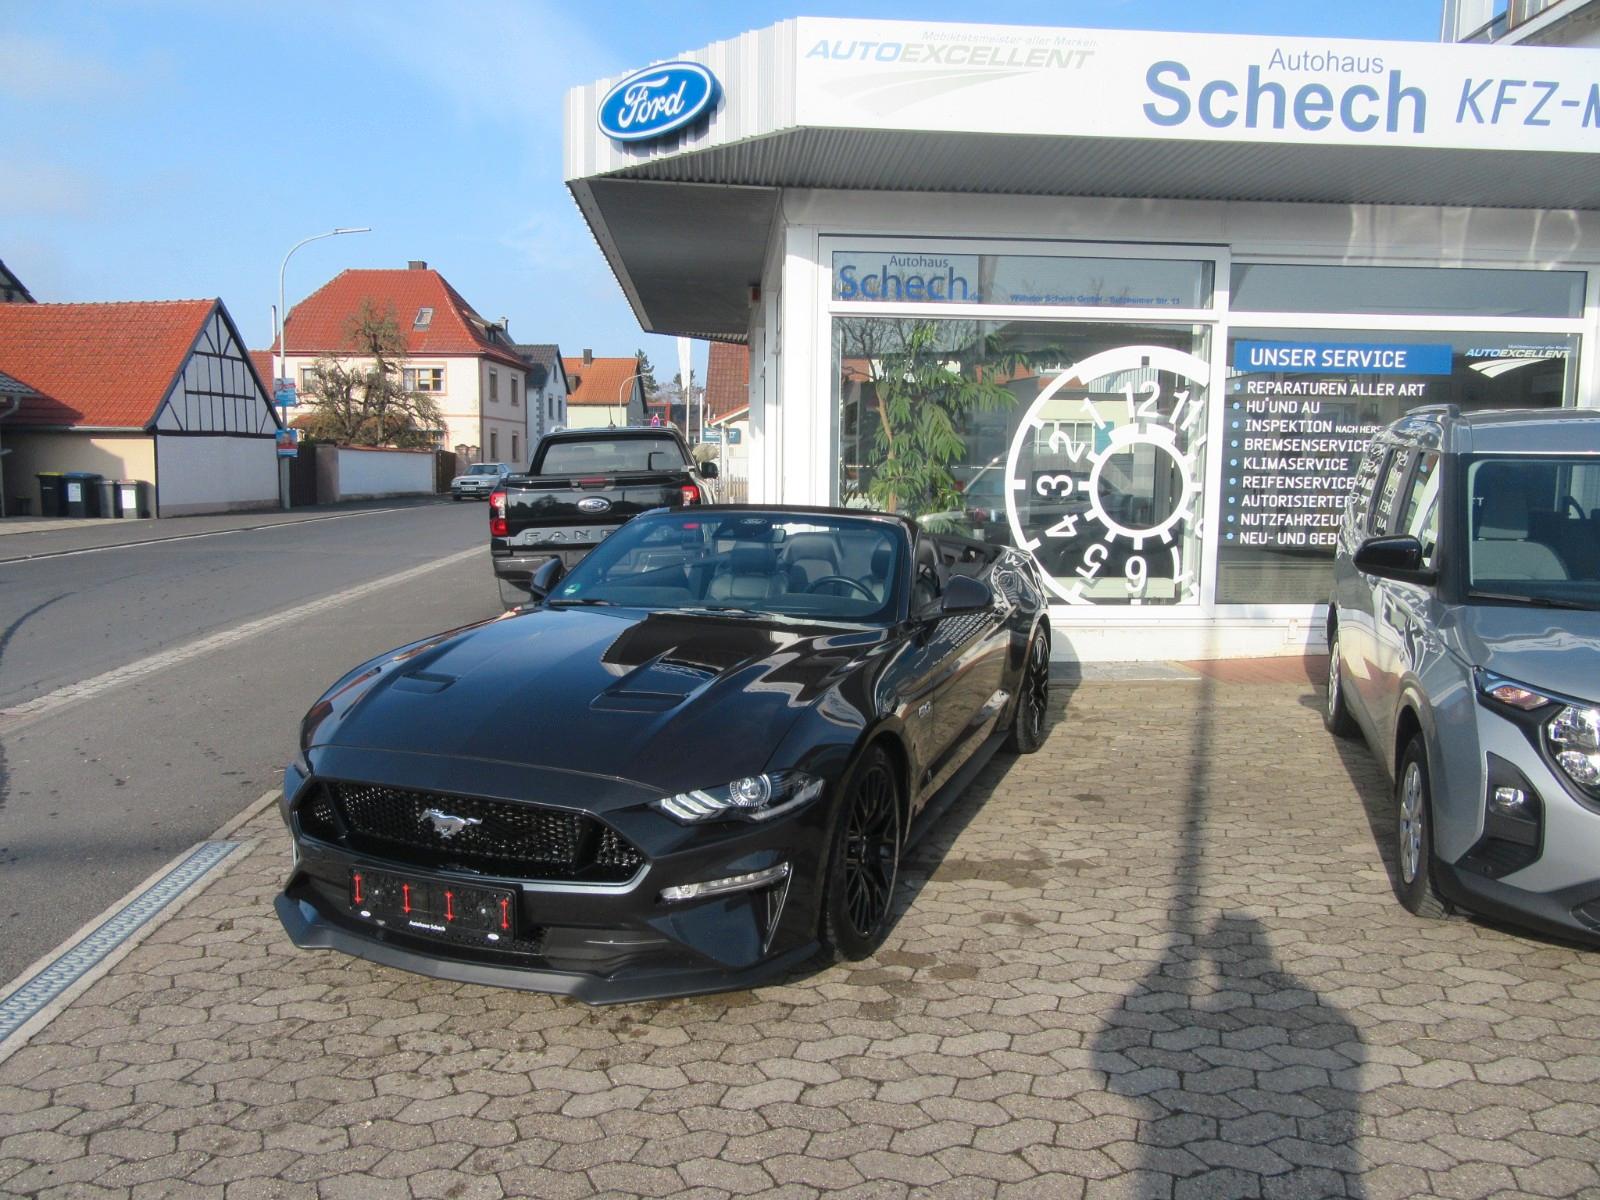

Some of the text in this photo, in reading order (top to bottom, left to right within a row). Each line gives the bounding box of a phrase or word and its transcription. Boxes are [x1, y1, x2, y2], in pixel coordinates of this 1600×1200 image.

[805, 39, 1095, 70] AUTOEXCELLENT
[1268, 48, 1384, 74] Autohaus
[618, 75, 687, 128] Ford
[1142, 60, 1427, 133] Schech
[889, 255, 949, 268] Autohaus
[839, 265, 968, 300] Schech
[1251, 348, 1407, 368] UNSER SERVICE
[1465, 348, 1572, 359] AUTOEXCELLENT
[1247, 381, 1426, 396] REPARATUREN ALLER ART
[1118, 381, 1161, 419] 12
[1246, 400, 1320, 414] HU UND AU
[1080, 397, 1106, 429] 1
[1245, 419, 1332, 433] INSPEKTION
[1335, 425, 1358, 434] NACH
[1049, 431, 1086, 463] 2
[1244, 439, 1371, 452] BREMSENSERVICE
[1243, 457, 1349, 471] KLIMASERVICE
[1036, 475, 1073, 497] 3
[1242, 476, 1355, 489] REIFENSERVICE
[1045, 514, 1078, 538] 4
[1239, 532, 1340, 545] NEU- UND GEB
[1075, 543, 1108, 579] 5
